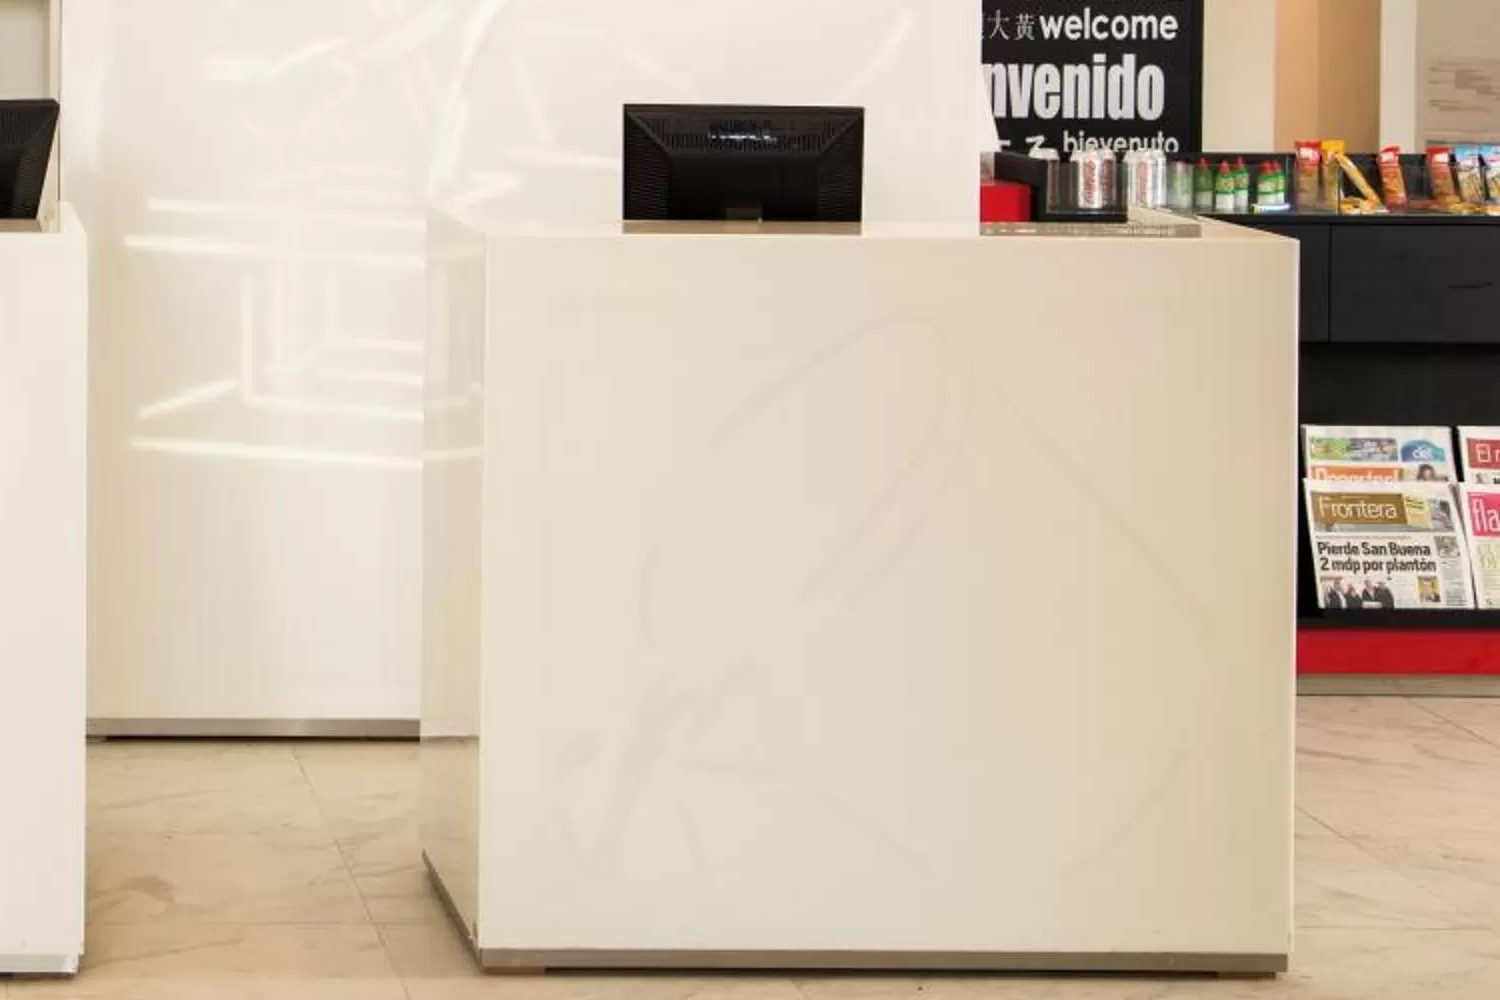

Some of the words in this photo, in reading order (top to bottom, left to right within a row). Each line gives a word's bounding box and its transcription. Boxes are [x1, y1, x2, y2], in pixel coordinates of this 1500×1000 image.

[1039, 7, 1179, 40] welcome
[1319, 496, 1397, 519] Frontera
[1317, 541, 1360, 556] Pierde
[1362, 542, 1387, 556] San
[1389, 543, 1431, 556] Buena
[1320, 557, 1330, 571] 2
[1332, 558, 1361, 574] mdp
[1363, 560, 1383, 574] por
[1386, 557, 1437, 574] plantón
